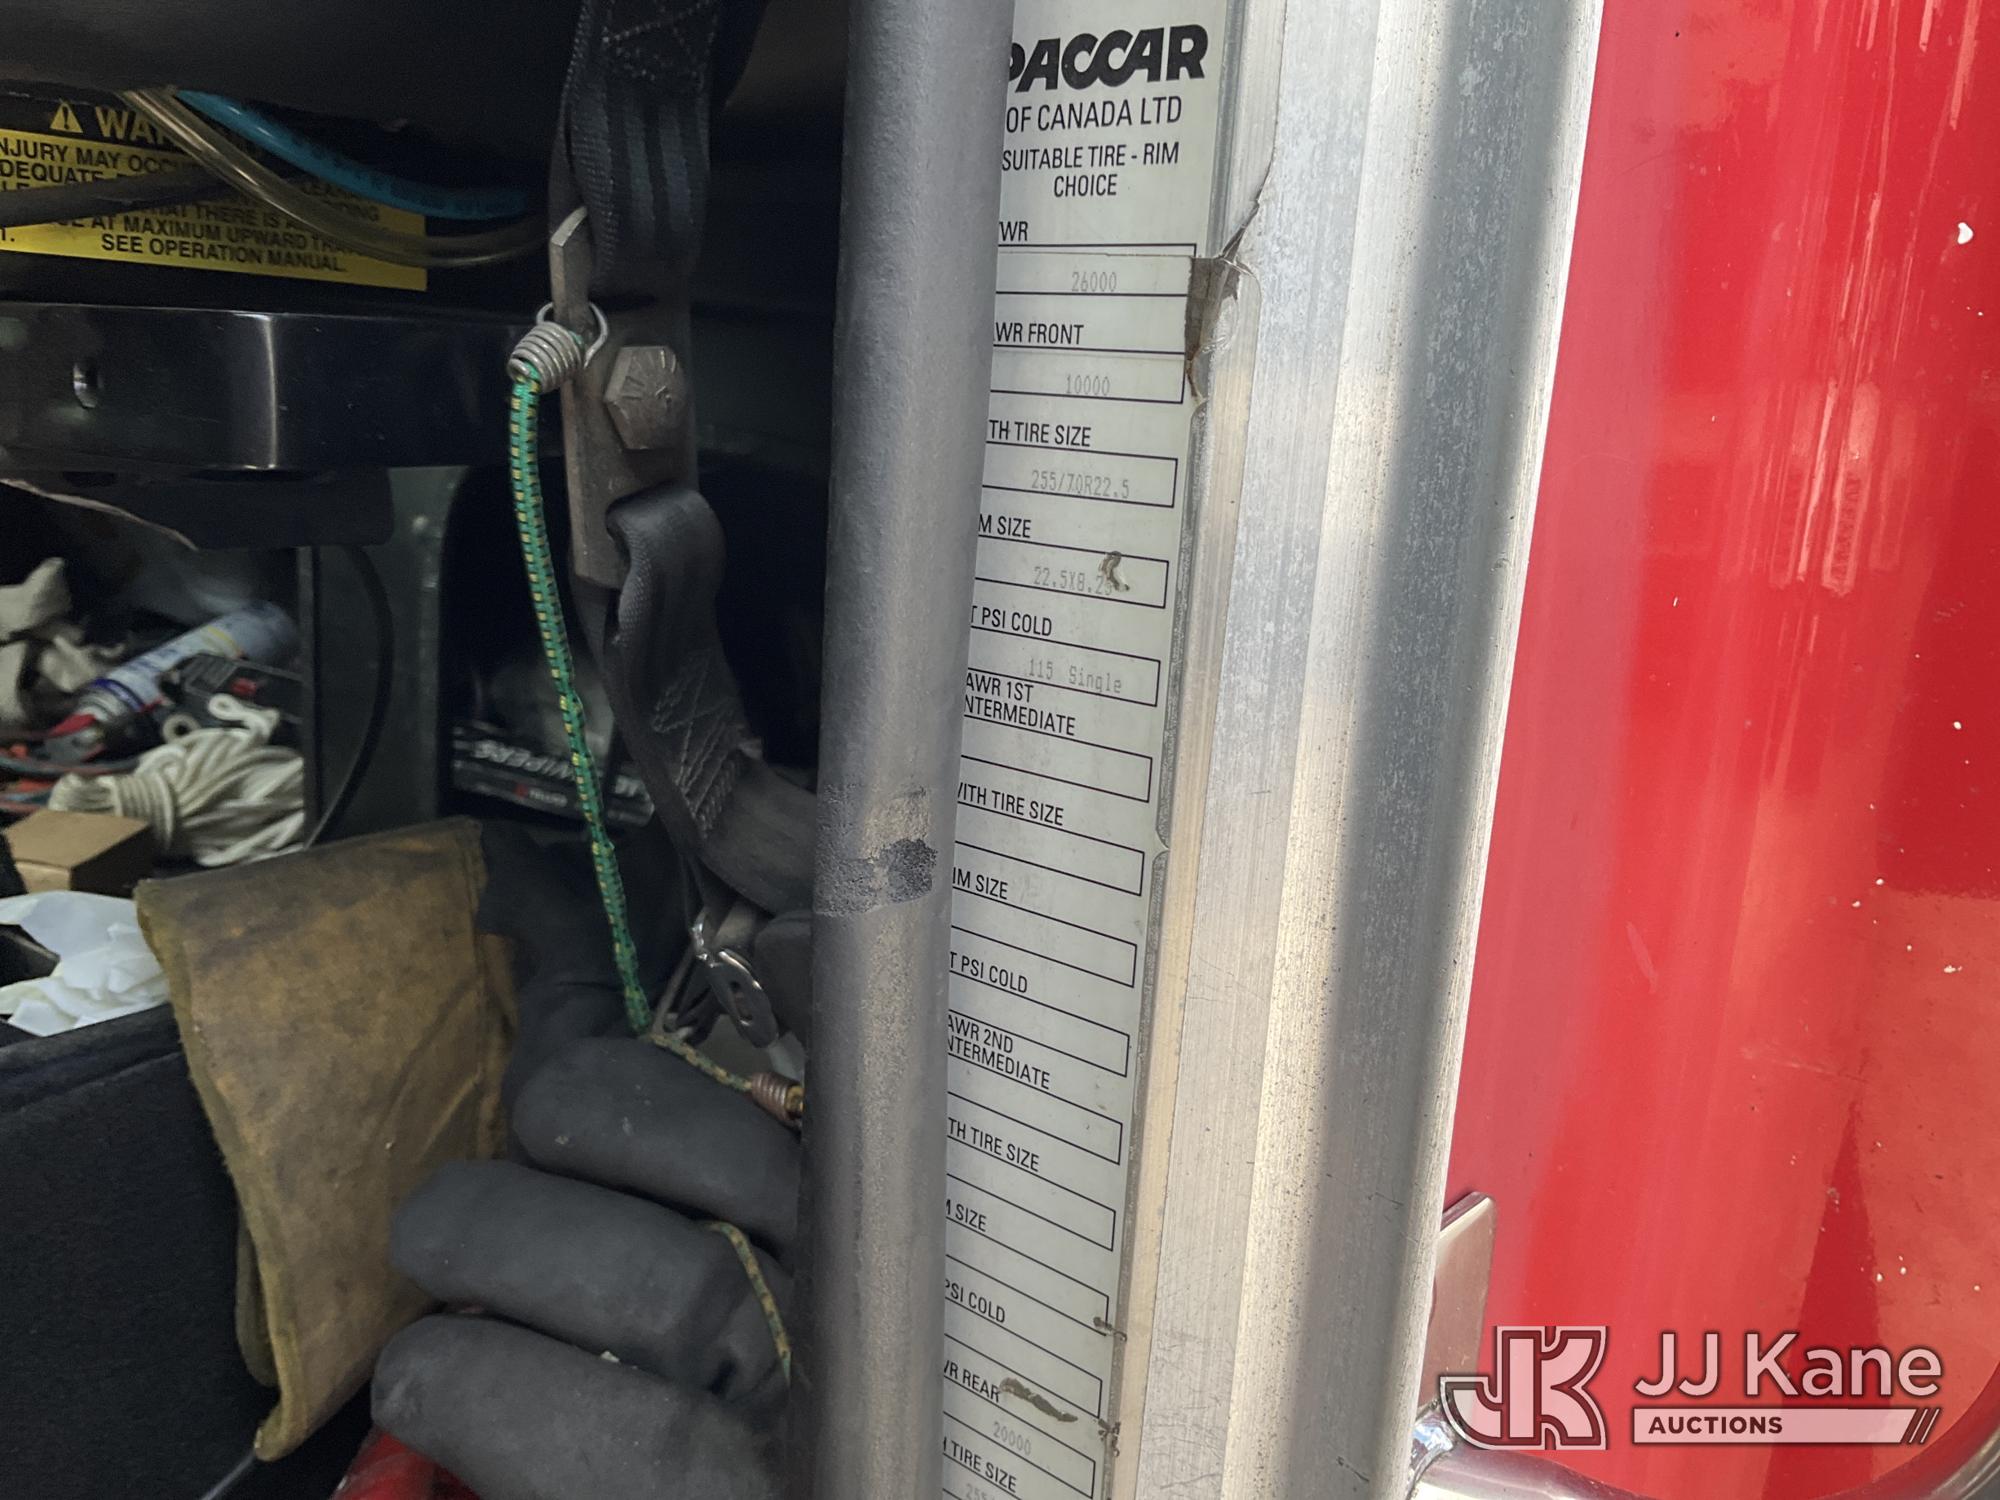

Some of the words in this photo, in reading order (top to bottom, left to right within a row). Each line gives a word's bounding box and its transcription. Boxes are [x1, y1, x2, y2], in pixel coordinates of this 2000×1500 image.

[1006, 106, 1032, 133] OF
[1037, 99, 1132, 131] CANADA
[1140, 96, 1182, 125] LTD
[76, 147, 120, 170] MAY
[1002, 146, 1083, 171] SUITABLE
[1088, 144, 1127, 167] TIRE
[1143, 141, 1180, 165] RIM
[1054, 174, 1118, 198] CHOICE
[101, 233, 144, 255] SEE
[148, 238, 262, 265] OPERATION
[1071, 271, 1118, 293] 26000
[1028, 323, 1084, 345] FRONT
[1066, 374, 1111, 397] 10000
[988, 418, 1010, 440] TH
[1014, 421, 1050, 444] TIRE
[1055, 424, 1092, 447] SIZE
[996, 516, 1032, 539] SIZE
[981, 607, 1006, 629] PSI
[1011, 610, 1053, 636] COLD
[1006, 680, 1035, 703] 1ST
[991, 789, 1025, 816] TIRE
[1029, 799, 1064, 826] SIZE
[975, 873, 1009, 901] SIZE
[961, 954, 984, 979] PSI
[989, 964, 1028, 994] COLD
[984, 1028, 1014, 1054] 2ND
[970, 1125, 1003, 1156] TIRE
[1006, 1143, 1040, 1174] SIZE
[955, 1203, 988, 1233] SIZE
[968, 1291, 1006, 1324] COLD
[962, 1367, 1000, 1404] REAR
[992, 1421, 1032, 1456] 20000
[951, 1440, 982, 1472] TIRE
[985, 1461, 1017, 1494] SIZE
